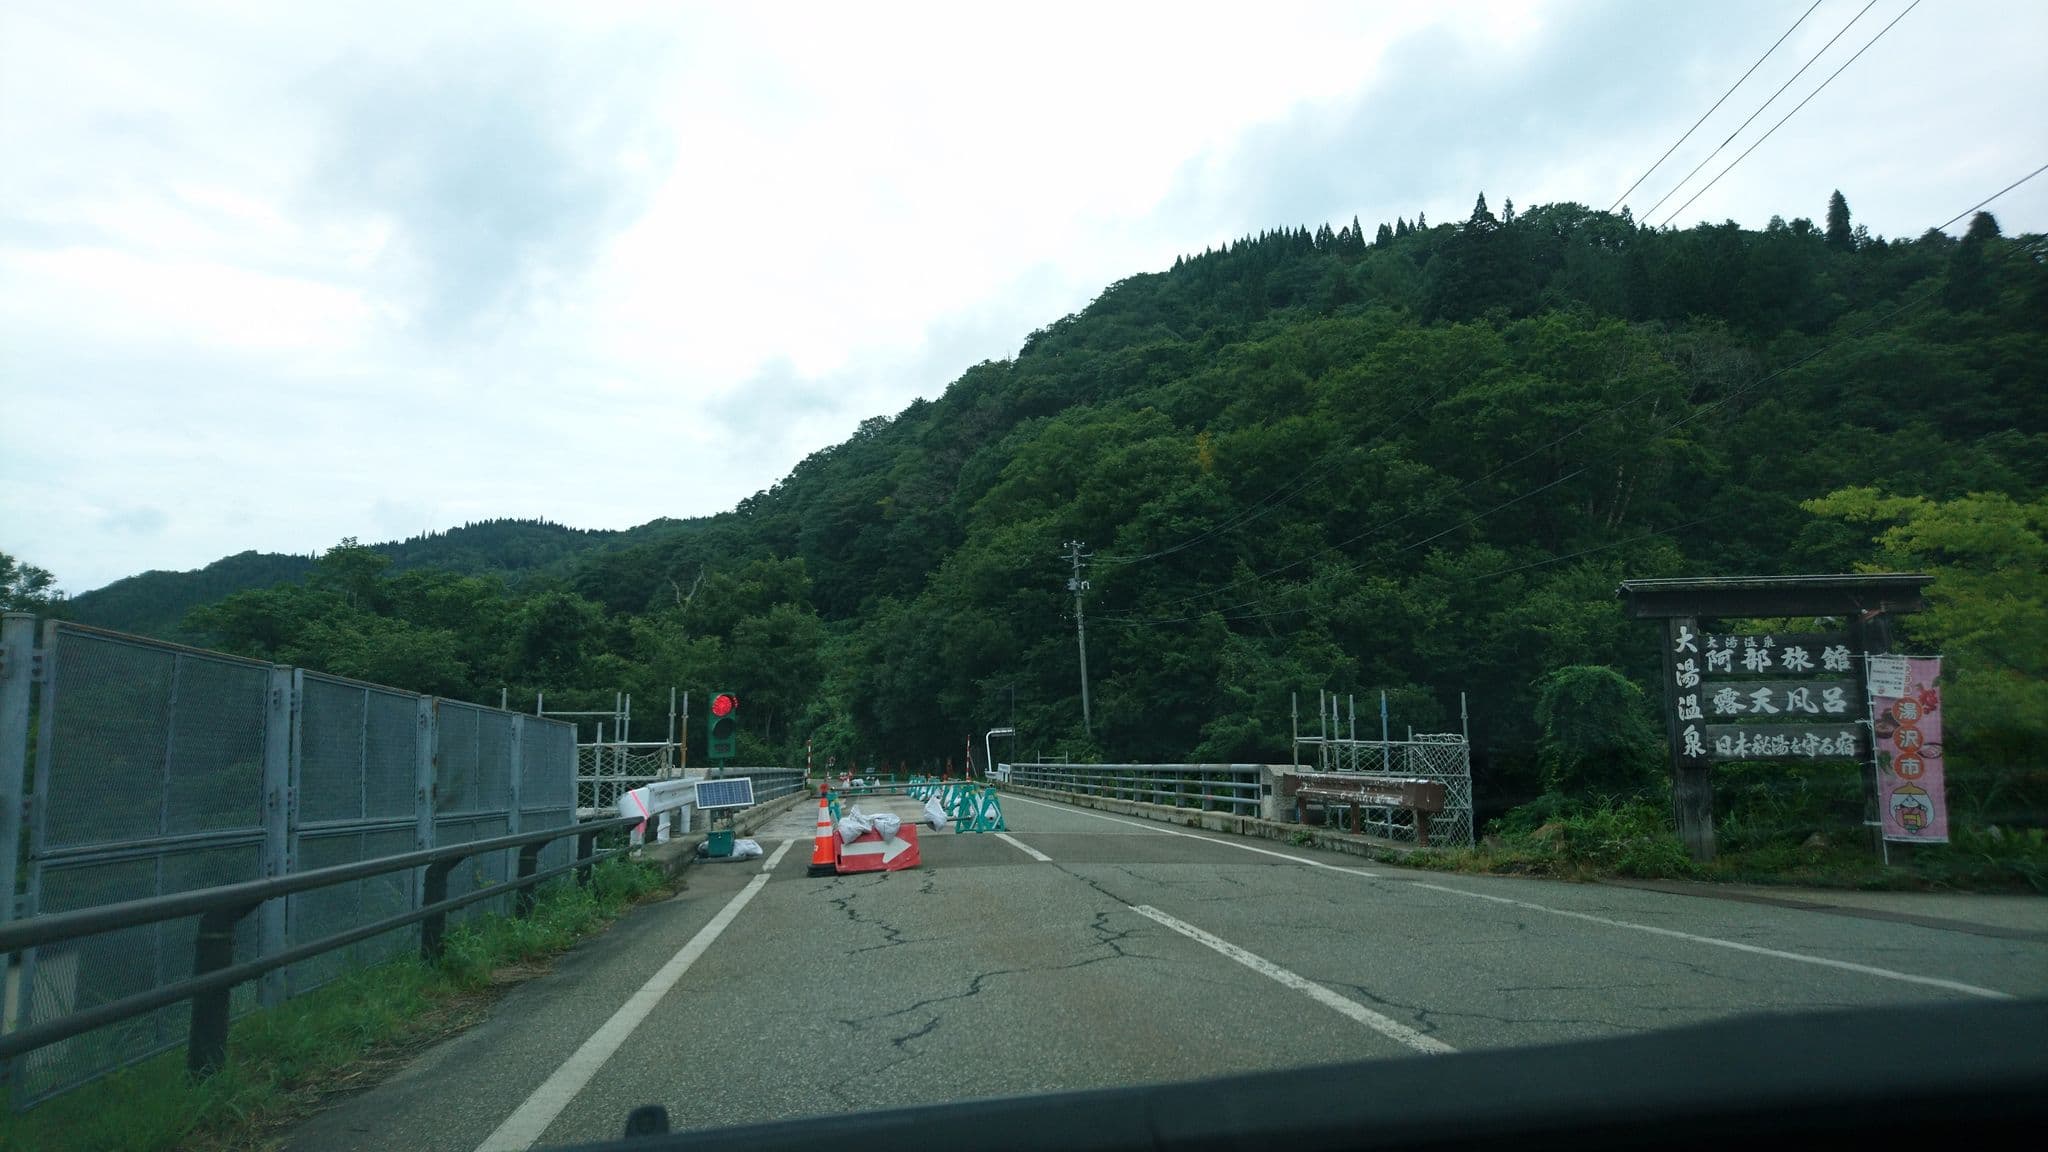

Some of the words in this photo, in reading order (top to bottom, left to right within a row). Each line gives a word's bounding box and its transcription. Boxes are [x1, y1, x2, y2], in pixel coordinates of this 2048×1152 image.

[1706, 635, 1777, 649] 大湯温泉
[1705, 645, 1851, 673] 阿部旅館
[1674, 626, 1707, 758] 大湯温泉
[1712, 687, 1847, 714] 露天風呂
[1715, 731, 1857, 758] 日本秘湯を守る宿
[1898, 702, 1920, 775] 湯沢市
